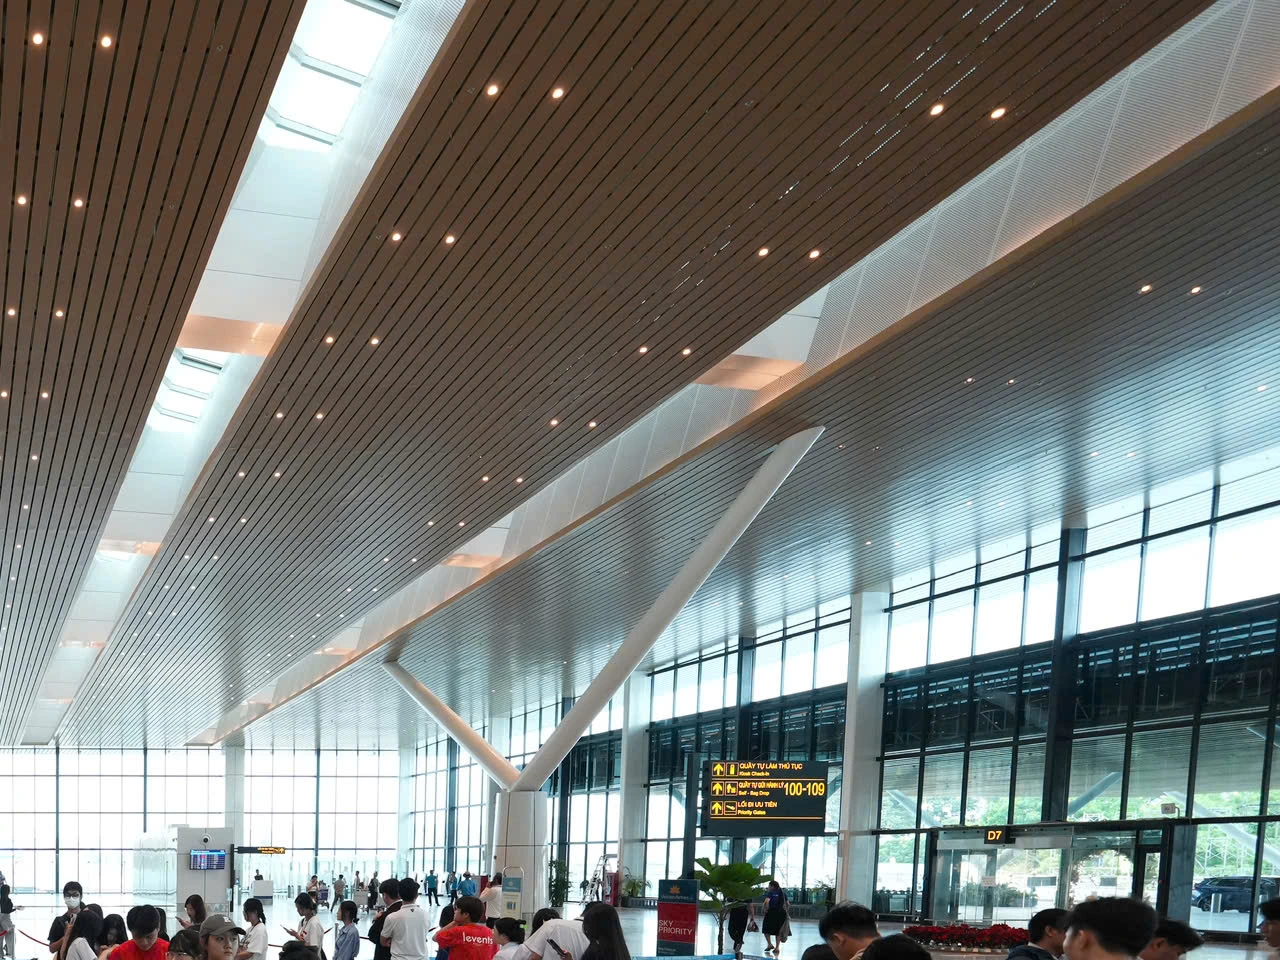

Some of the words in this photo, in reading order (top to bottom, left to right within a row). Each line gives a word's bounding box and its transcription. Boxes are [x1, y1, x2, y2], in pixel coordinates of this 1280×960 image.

[784, 782, 825, 796] 100-109
[987, 831, 1002, 840] D7
[658, 919, 673, 927] SKY
[658, 926, 693, 935] PRIORITY
